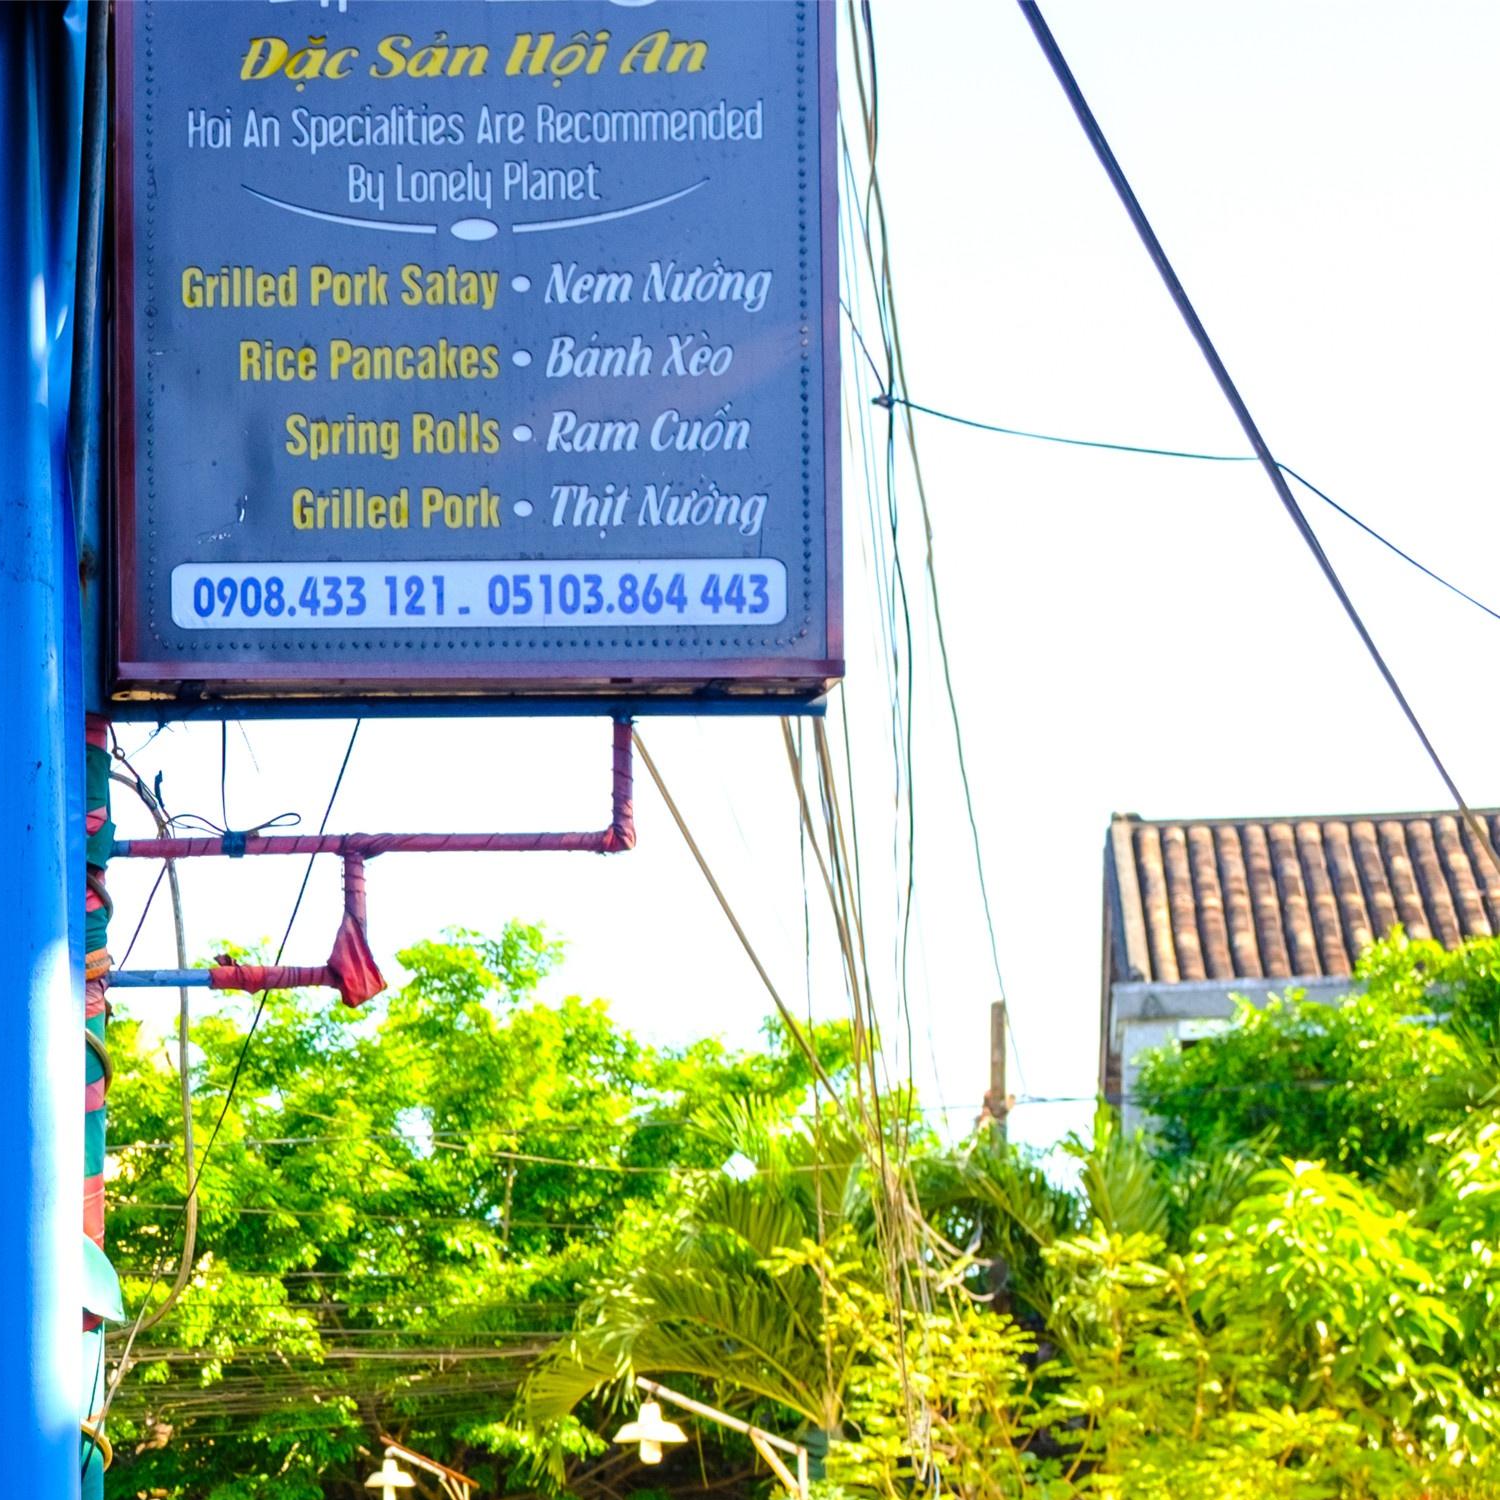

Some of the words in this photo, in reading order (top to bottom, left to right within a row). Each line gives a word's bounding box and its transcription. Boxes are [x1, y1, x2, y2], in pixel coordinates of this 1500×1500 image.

[240, 35, 359, 92] Đặc
[370, 31, 489, 79] Sản
[506, 29, 612, 88] Hội
[620, 29, 708, 75] An
[188, 107, 232, 149] Hoi
[244, 108, 281, 148] An
[292, 104, 464, 154] Specialities
[477, 104, 524, 145] Are
[536, 100, 764, 145] Recommended
[348, 163, 385, 210] By
[397, 161, 492, 209] Lonely
[504, 160, 601, 201] Planet
[182, 265, 298, 308] Grilled
[310, 265, 388, 306] Pork
[401, 263, 499, 310] Satay
[545, 261, 633, 304] Nem
[643, 257, 773, 312] Nướng
[240, 339, 317, 381] Rice
[330, 337, 499, 381] Pancakes
[546, 332, 653, 378] Bánh
[662, 330, 734, 377] Xèo
[286, 413, 399, 460] Spring
[413, 412, 500, 454] Rolls
[547, 409, 640, 452] Ram
[651, 402, 750, 451] Cuốn
[292, 488, 409, 530] Grilled
[422, 487, 500, 529] Pork
[551, 483, 632, 539] Thịt
[638, 481, 768, 536] Nướng
[193, 575, 367, 617] 0908.433
[384, 574, 445, 616] 121
[488, 573, 688, 616] 05103.864
[700, 573, 770, 614] 443
